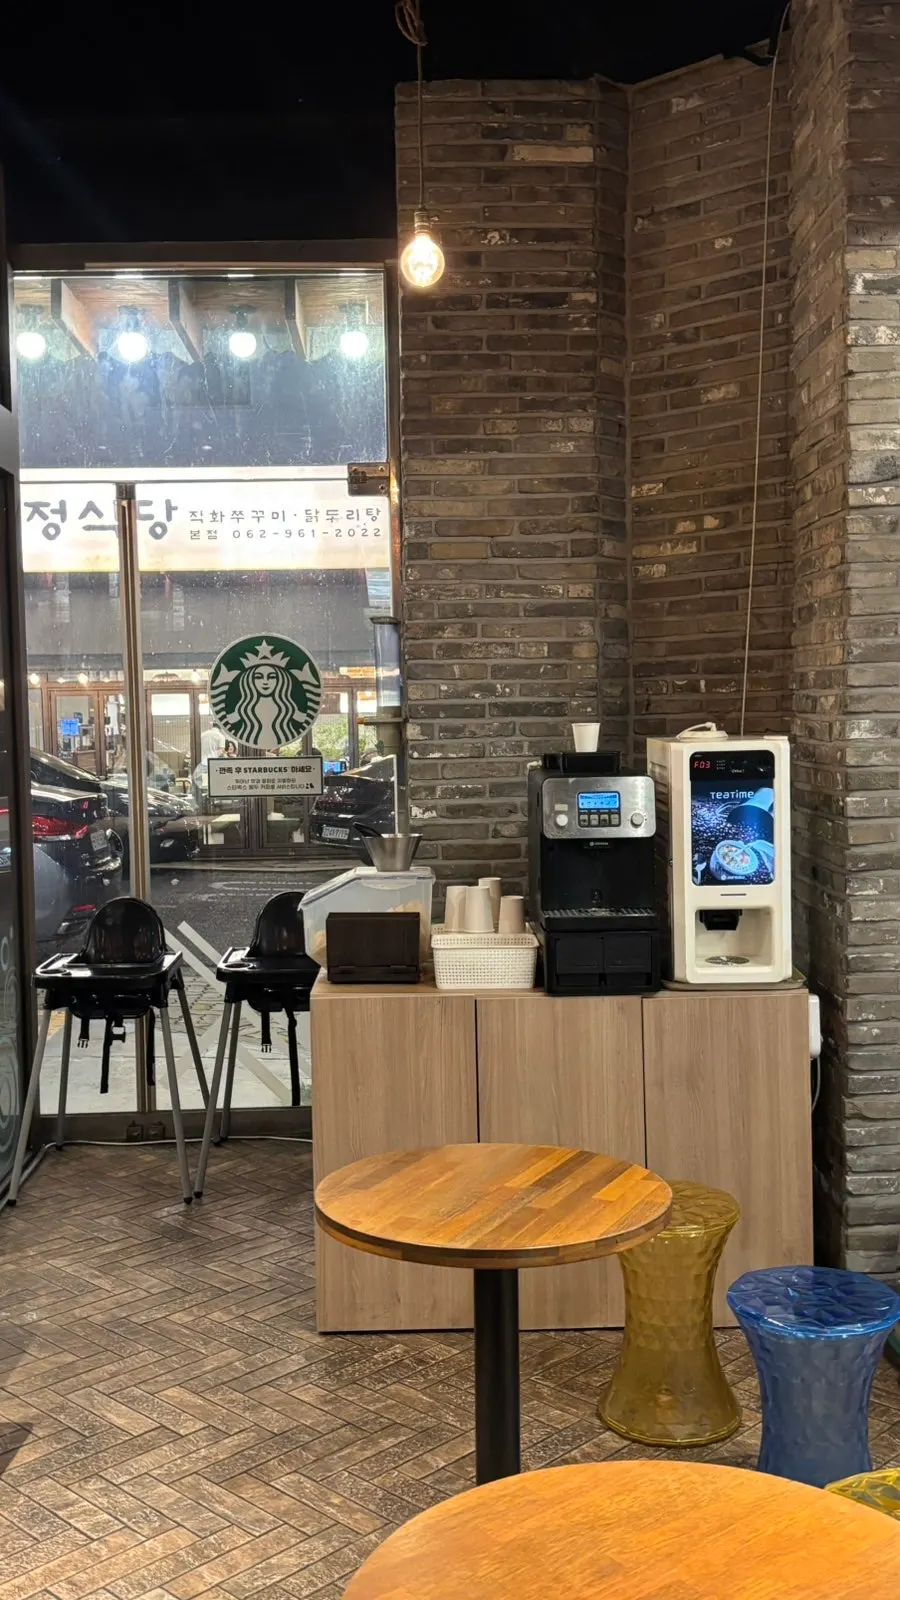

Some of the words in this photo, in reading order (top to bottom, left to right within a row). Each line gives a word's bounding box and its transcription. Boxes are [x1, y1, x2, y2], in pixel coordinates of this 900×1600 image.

[190, 529, 218, 540] 본점
[232, 528, 381, 539] 062-961-2022
[243, 766, 288, 774] STARBUCKS
[291, 765, 312, 774] 하세요
